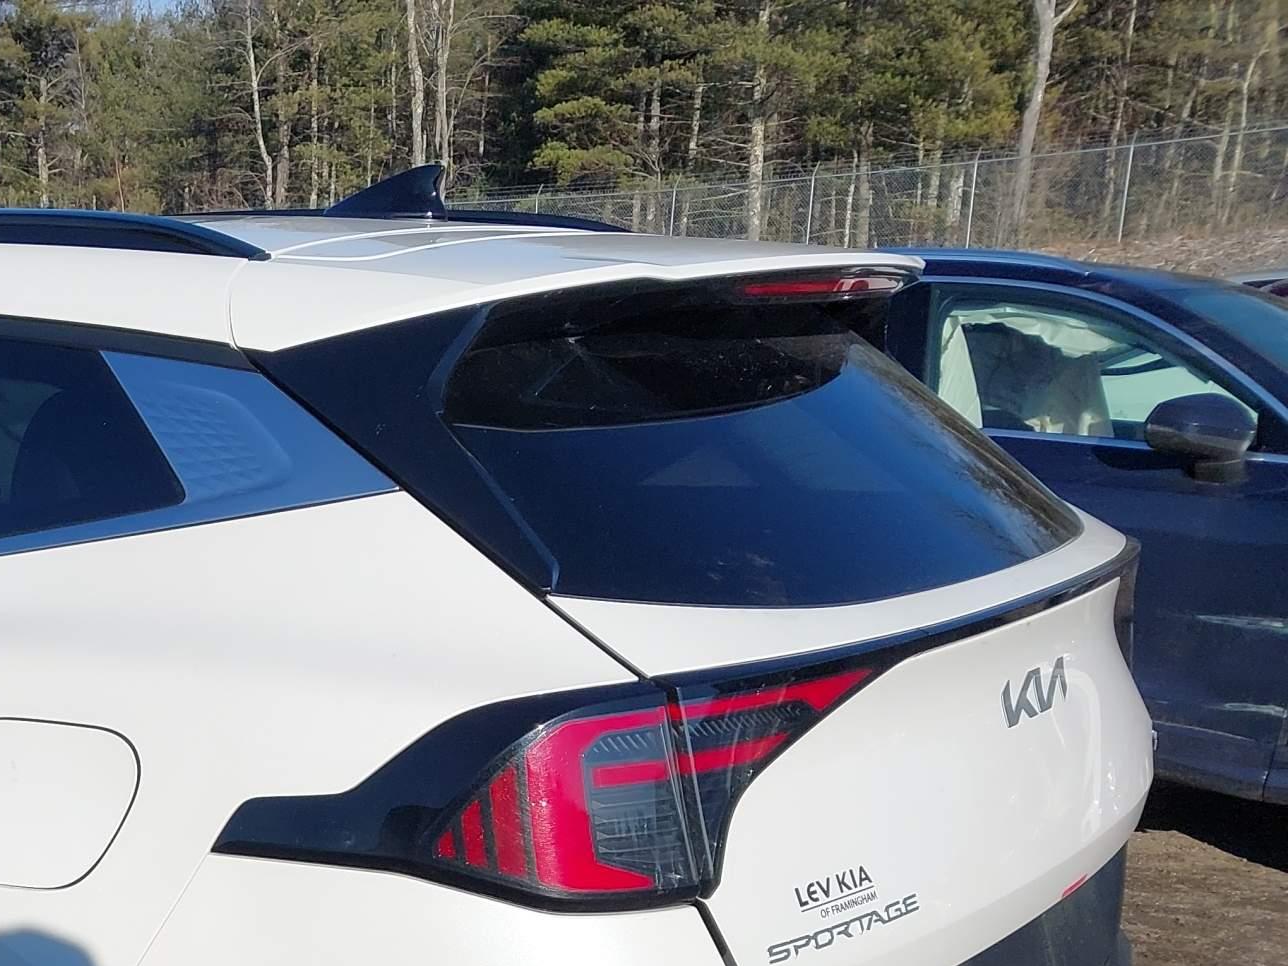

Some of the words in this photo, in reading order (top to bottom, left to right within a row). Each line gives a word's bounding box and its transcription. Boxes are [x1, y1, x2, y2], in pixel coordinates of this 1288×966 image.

[794, 877, 830, 907] LEV
[835, 865, 873, 893] KIA
[820, 907, 830, 919] OF
[830, 890, 878, 916] FRAMINGHAM
[767, 893, 920, 964] SPORTAGE
